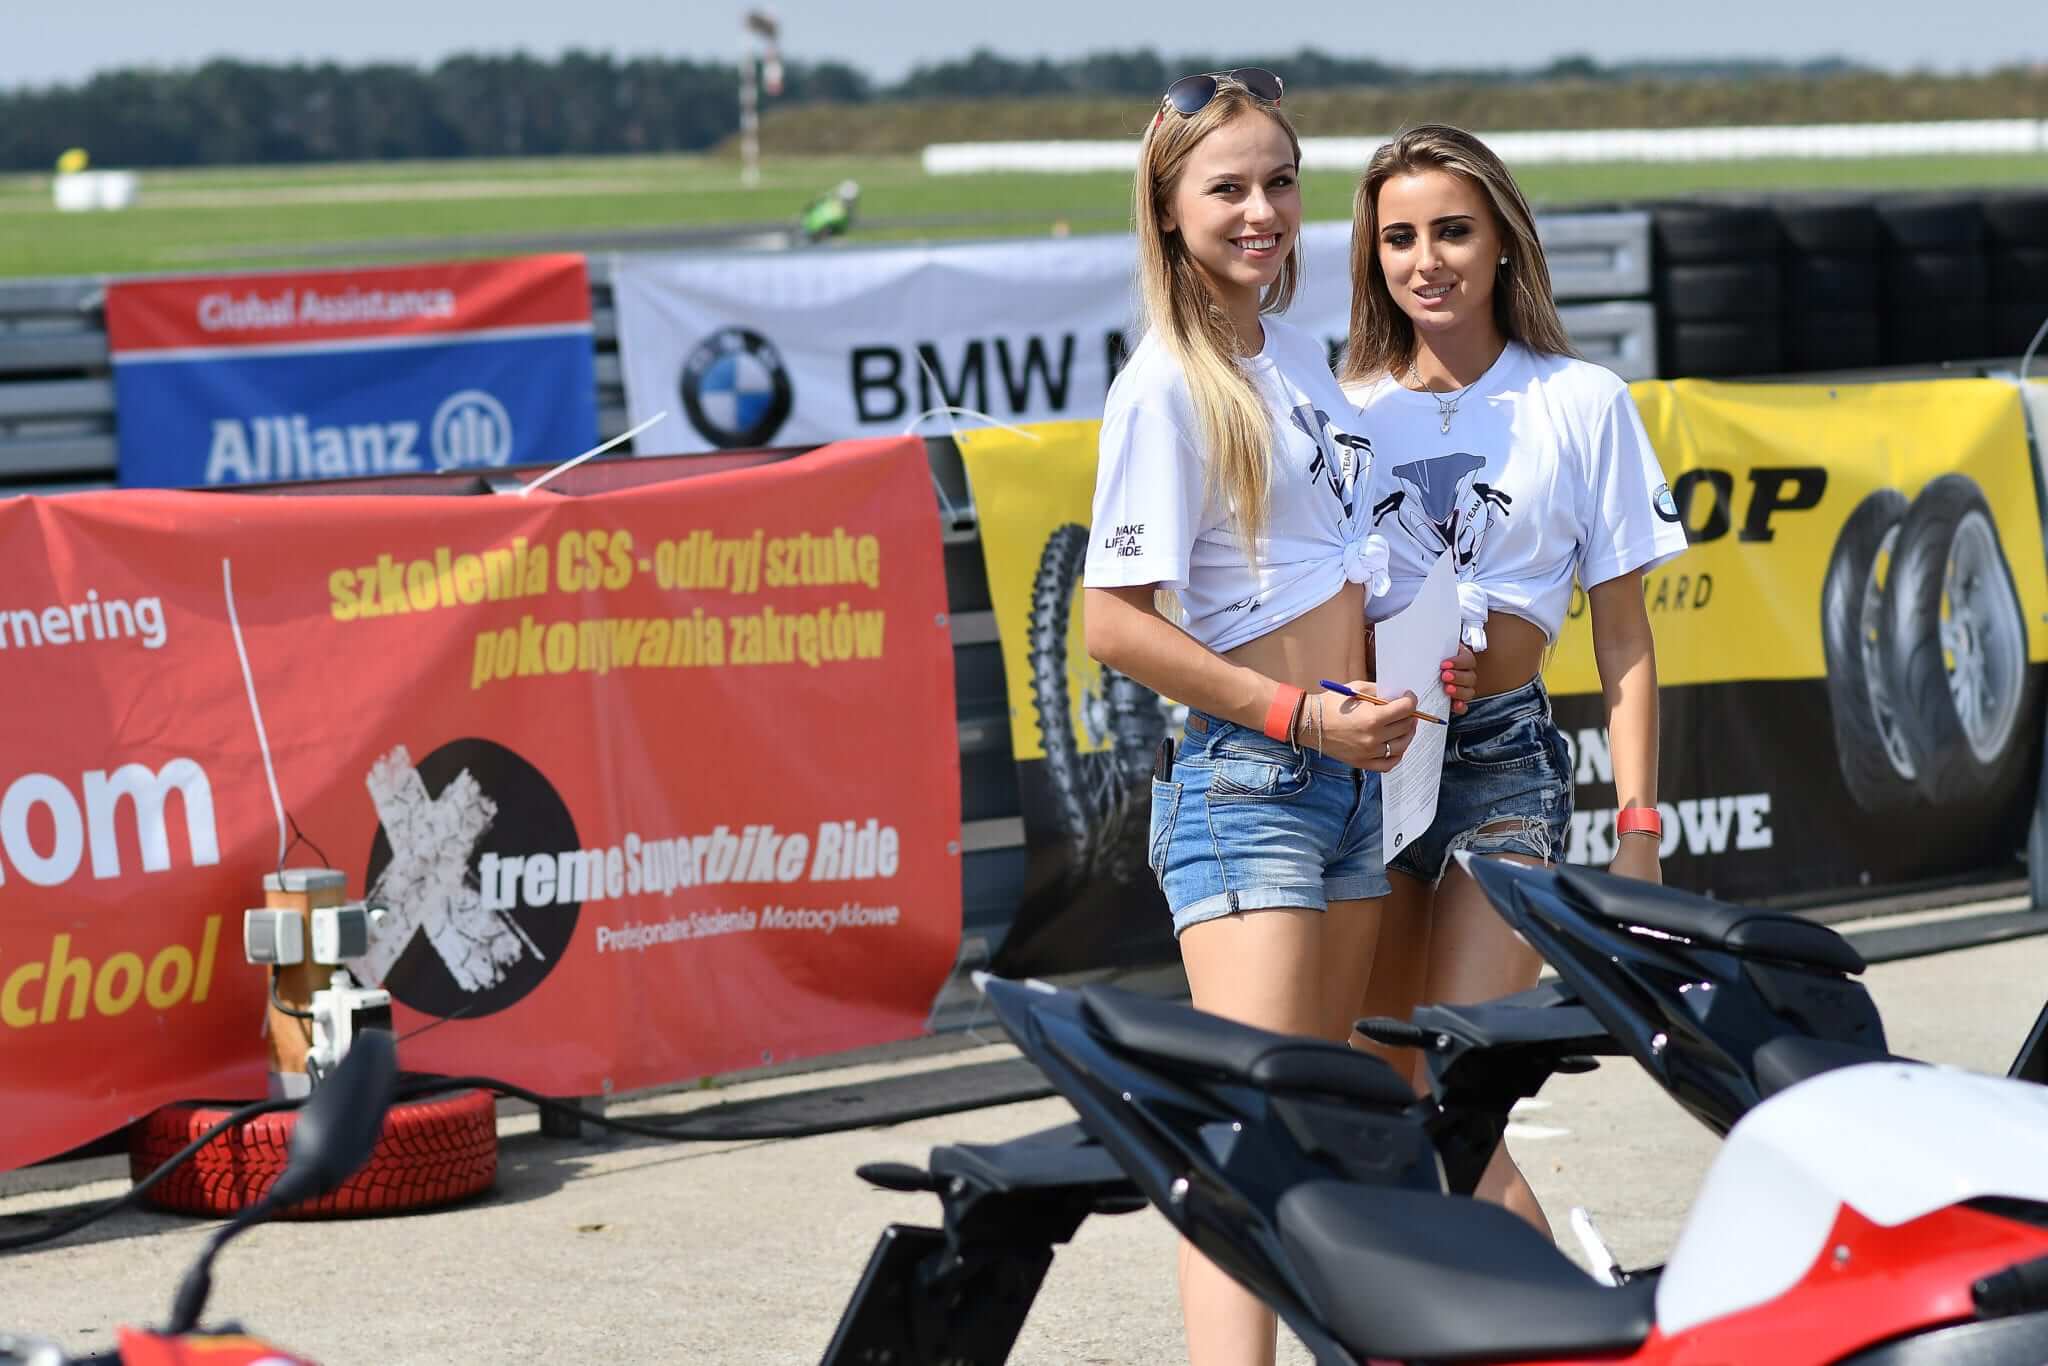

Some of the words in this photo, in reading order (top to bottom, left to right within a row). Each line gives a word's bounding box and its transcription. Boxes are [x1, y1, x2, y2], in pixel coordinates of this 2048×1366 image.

[197, 291, 295, 332] Global
[300, 285, 455, 323] Assistance
[850, 333, 1076, 424] BMW
[205, 414, 422, 482] Allianz
[1343, 448, 1352, 472] TEAM
[1105, 536, 1126, 549] LIFE
[1127, 535, 1136, 546] A
[1116, 524, 1145, 537] MAKE
[1466, 500, 1482, 521] TEAM
[329, 536, 548, 621] szkolenia
[556, 529, 633, 592] CSS
[655, 528, 764, 594] odkryj
[765, 527, 880, 590] sztukę
[1117, 545, 1144, 558] RIDE.
[729, 602, 885, 669] zakrętów
[0, 757, 220, 887] om
[811, 818, 900, 882] Ride
[0, 913, 223, 1029] chool
